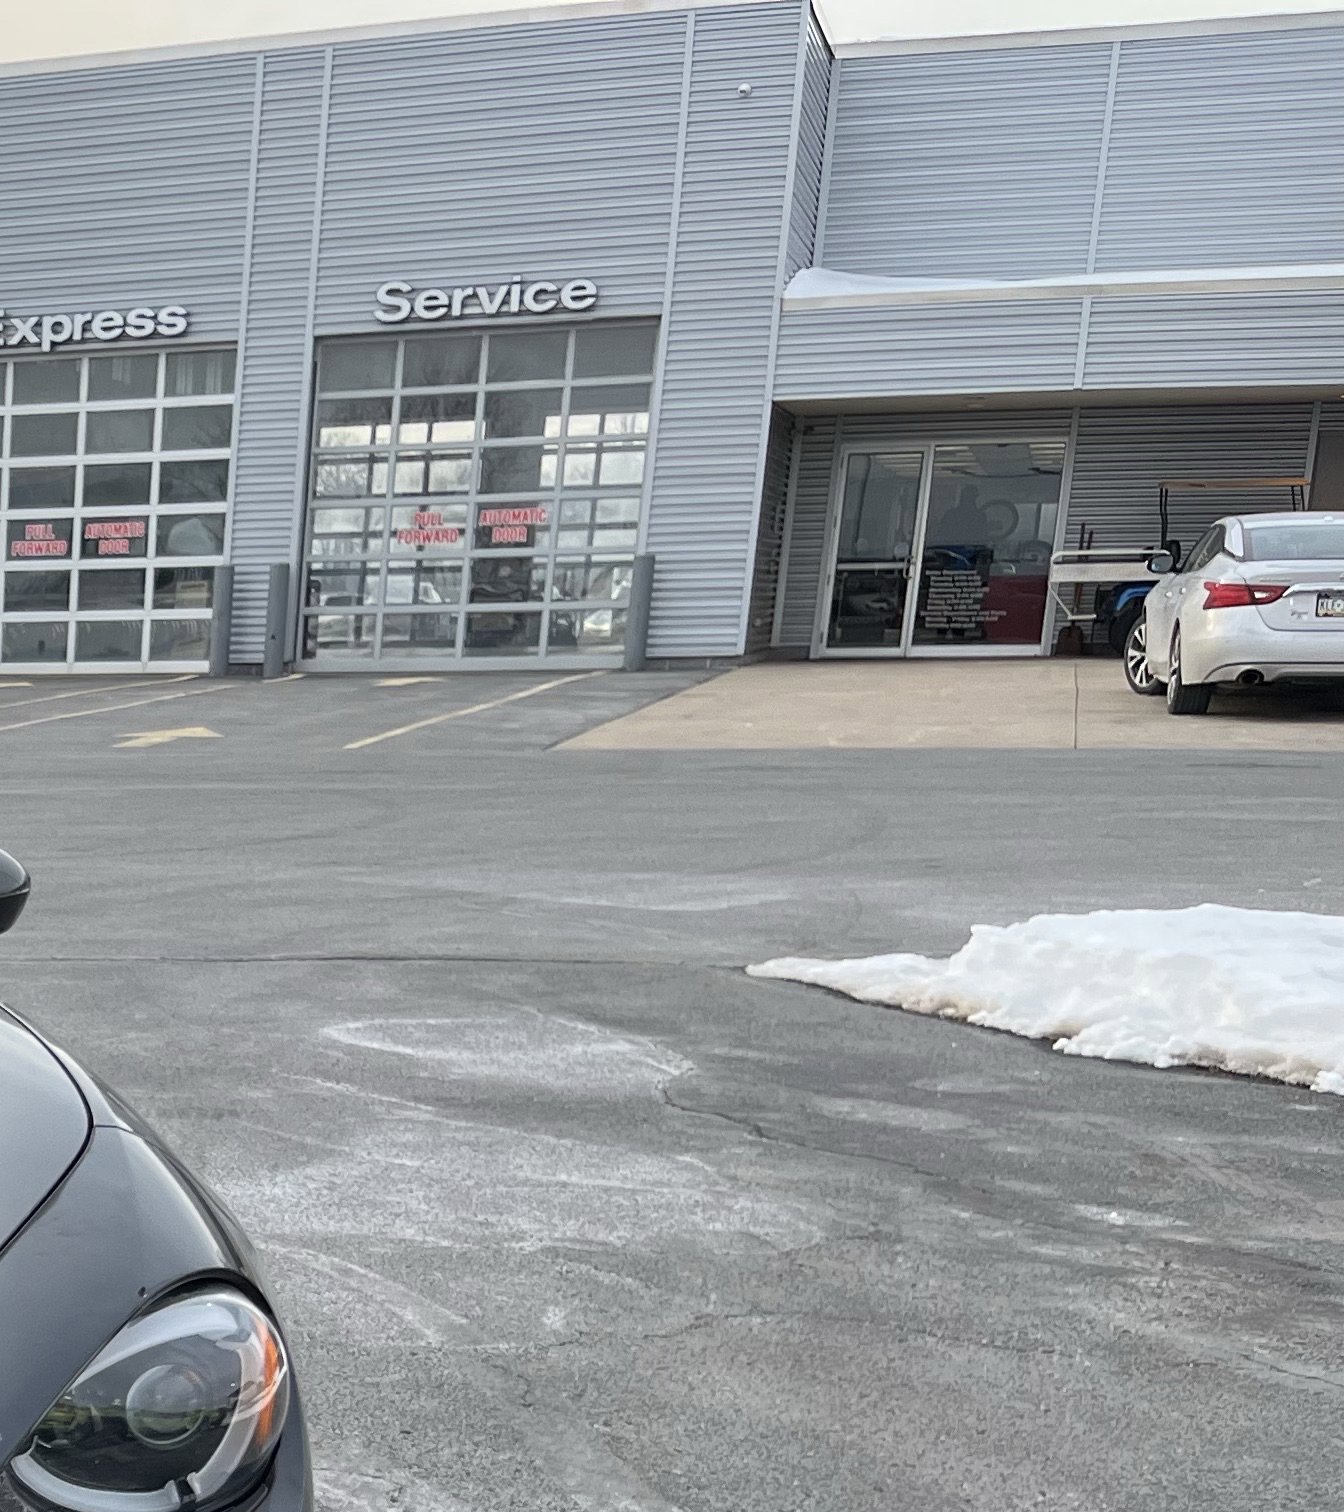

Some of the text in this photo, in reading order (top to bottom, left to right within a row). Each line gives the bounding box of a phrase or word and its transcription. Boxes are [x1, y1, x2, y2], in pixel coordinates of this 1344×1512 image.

[372, 275, 598, 323] Service
[413, 511, 444, 526] PULL
[478, 508, 548, 525] AUTOMATIC
[25, 524, 55, 540] PULL
[84, 522, 145, 539] AUTOMATIC
[397, 528, 460, 544] FORWARD
[492, 526, 527, 543] DOOR
[11, 540, 67, 556] FORWARD
[98, 539, 130, 555] DOOR
